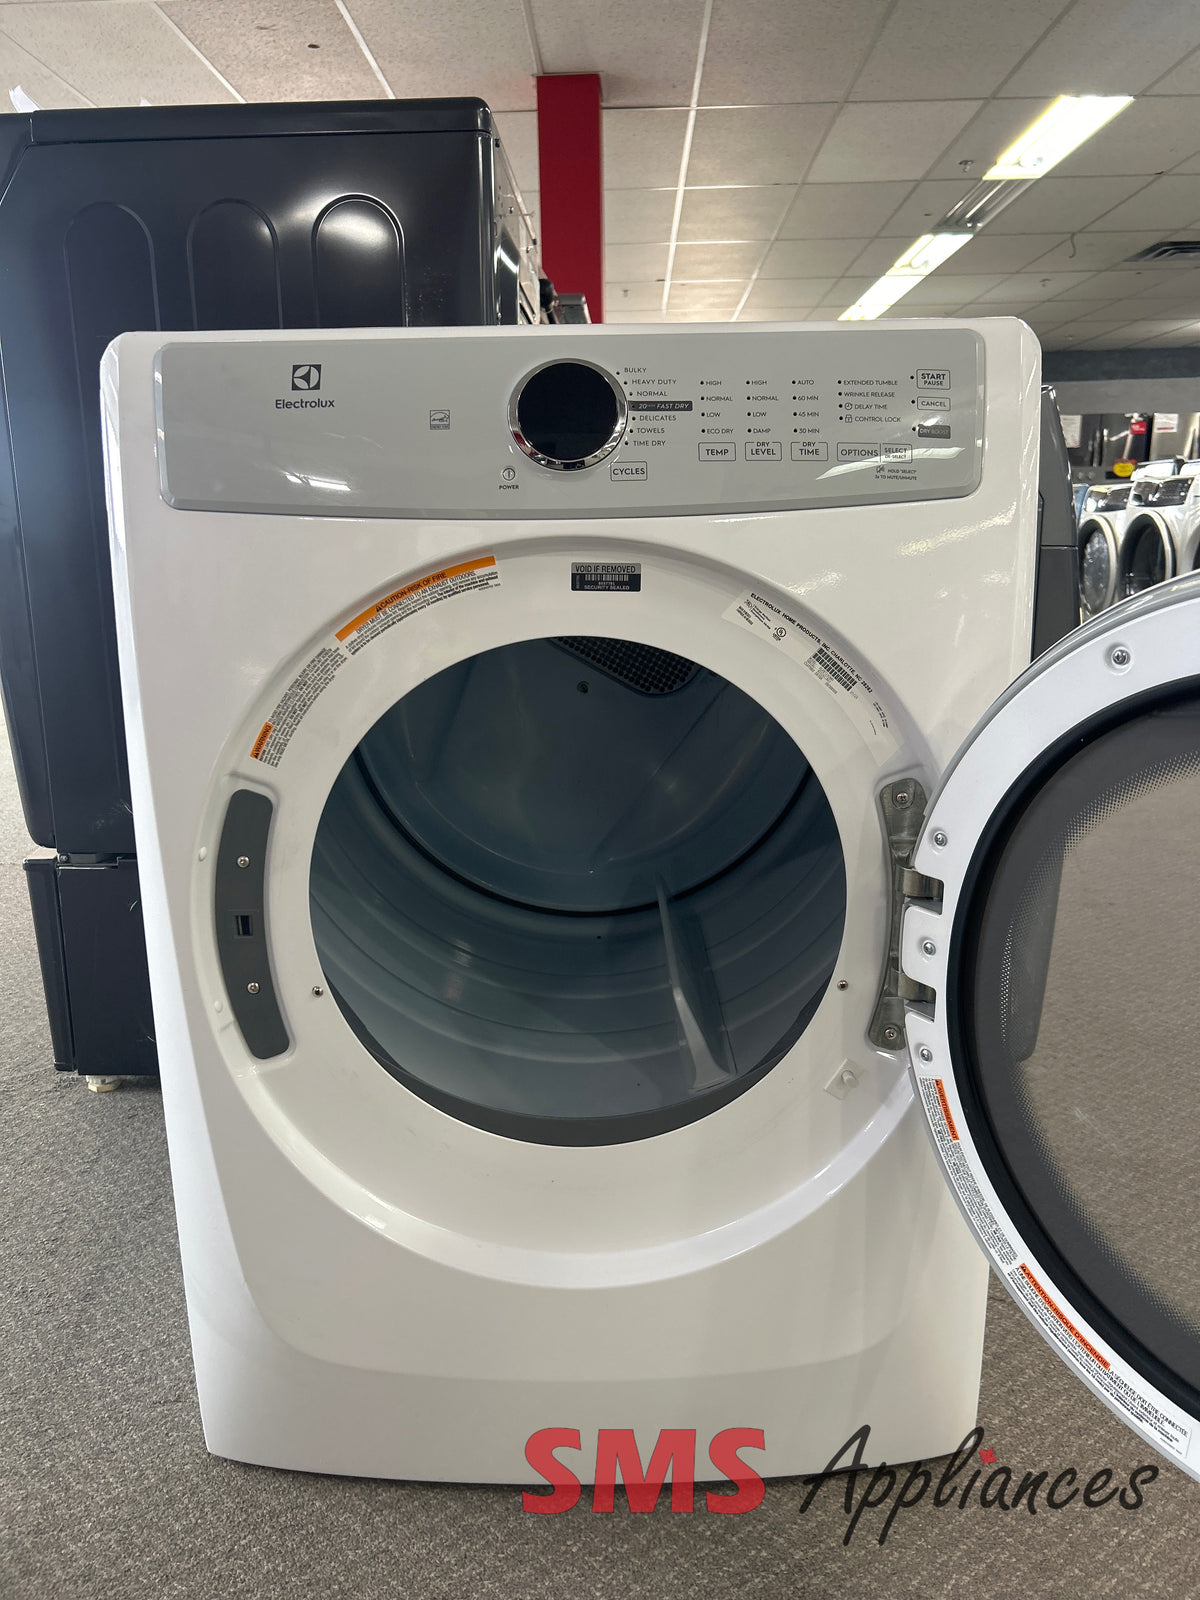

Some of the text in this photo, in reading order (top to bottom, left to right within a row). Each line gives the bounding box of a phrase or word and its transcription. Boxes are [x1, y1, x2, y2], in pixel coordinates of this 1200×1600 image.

[275, 398, 335, 409] Electrolux
[705, 448, 729, 456] TEMP
[750, 448, 776, 456] LEVEL
[799, 448, 820, 456] TIME
[613, 467, 646, 476] CYCLES
[593, 565, 600, 573] IF
[602, 565, 636, 573] REMOVED
[421, 576, 432, 586] OF
[431, 571, 447, 581] FIRE
[355, 621, 370, 634] DRYER
[368, 612, 382, 625] MUST
[750, 592, 782, 614] ELECTROLUX
[781, 612, 796, 624] HOME
[854, 673, 862, 681] NC
[254, 724, 272, 753] WARNING
[936, 1086, 958, 1141] AVERTISSEMENT
